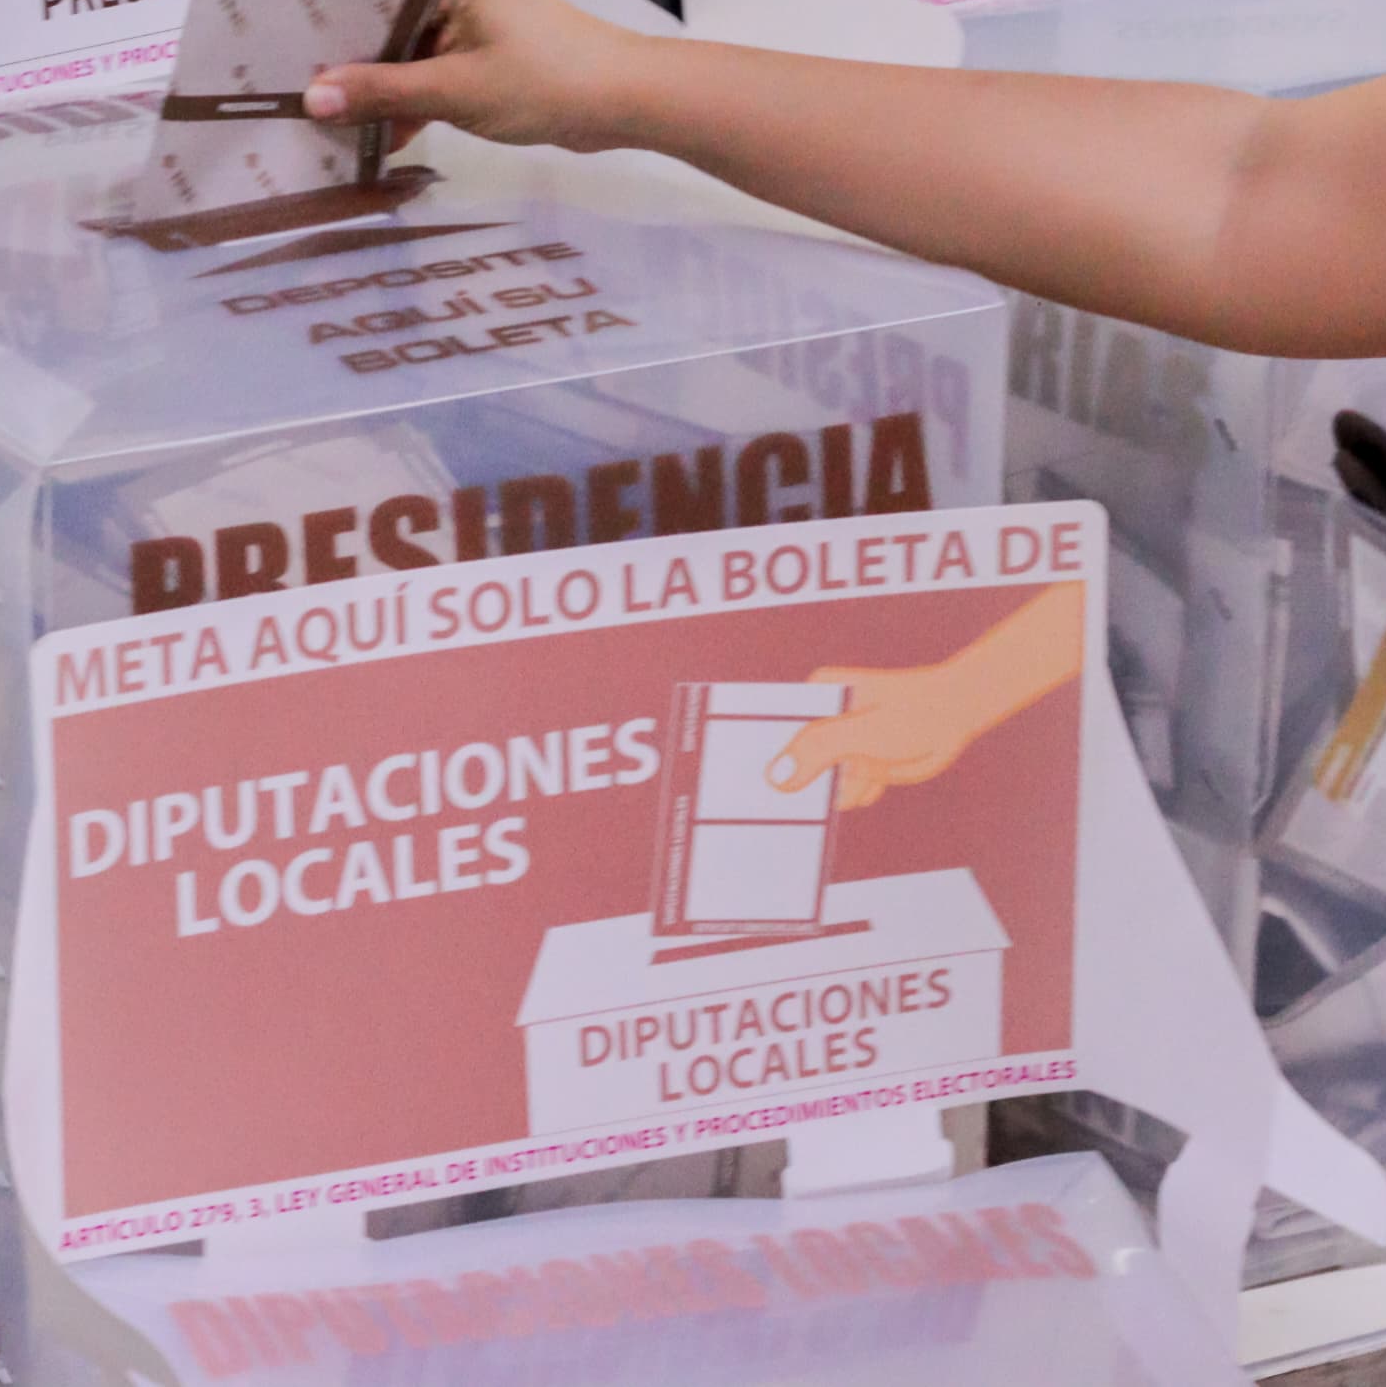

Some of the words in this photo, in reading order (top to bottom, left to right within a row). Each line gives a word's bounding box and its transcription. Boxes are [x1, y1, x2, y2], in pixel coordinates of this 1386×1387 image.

[101, 48, 114, 73] Y
[221, 241, 585, 316] DEPOSITE
[493, 277, 601, 309] SU
[339, 309, 640, 375] BOLETA
[55, 626, 230, 707] META
[249, 582, 409, 671] AQUÍ
[428, 569, 602, 641] SOLO
[621, 556, 700, 612] LA
[722, 529, 975, 602] BOLETA
[998, 521, 1083, 576] DE
[69, 716, 662, 879] DIPUTACIONES
[175, 816, 532, 938] LOCALES
[579, 967, 954, 1068] DIPUTACIONES
[659, 1027, 879, 1102] LOCALES
[59, 1210, 186, 1253] ARTÍCULO
[190, 1201, 241, 1229] 279,
[276, 1187, 323, 1215] LEY
[325, 1168, 442, 1207] GENERAL
[446, 1160, 478, 1185] DE
[484, 1126, 668, 1177] INSTITUCIONES
[675, 1121, 689, 1145] Y
[693, 1084, 909, 1141] PROCEDIMIENTOS
[911, 1059, 1079, 1103] ELECTORALES
[749, 1201, 1100, 1301] LOCALES
[166, 1237, 768, 1382] DIPUTACIONES
